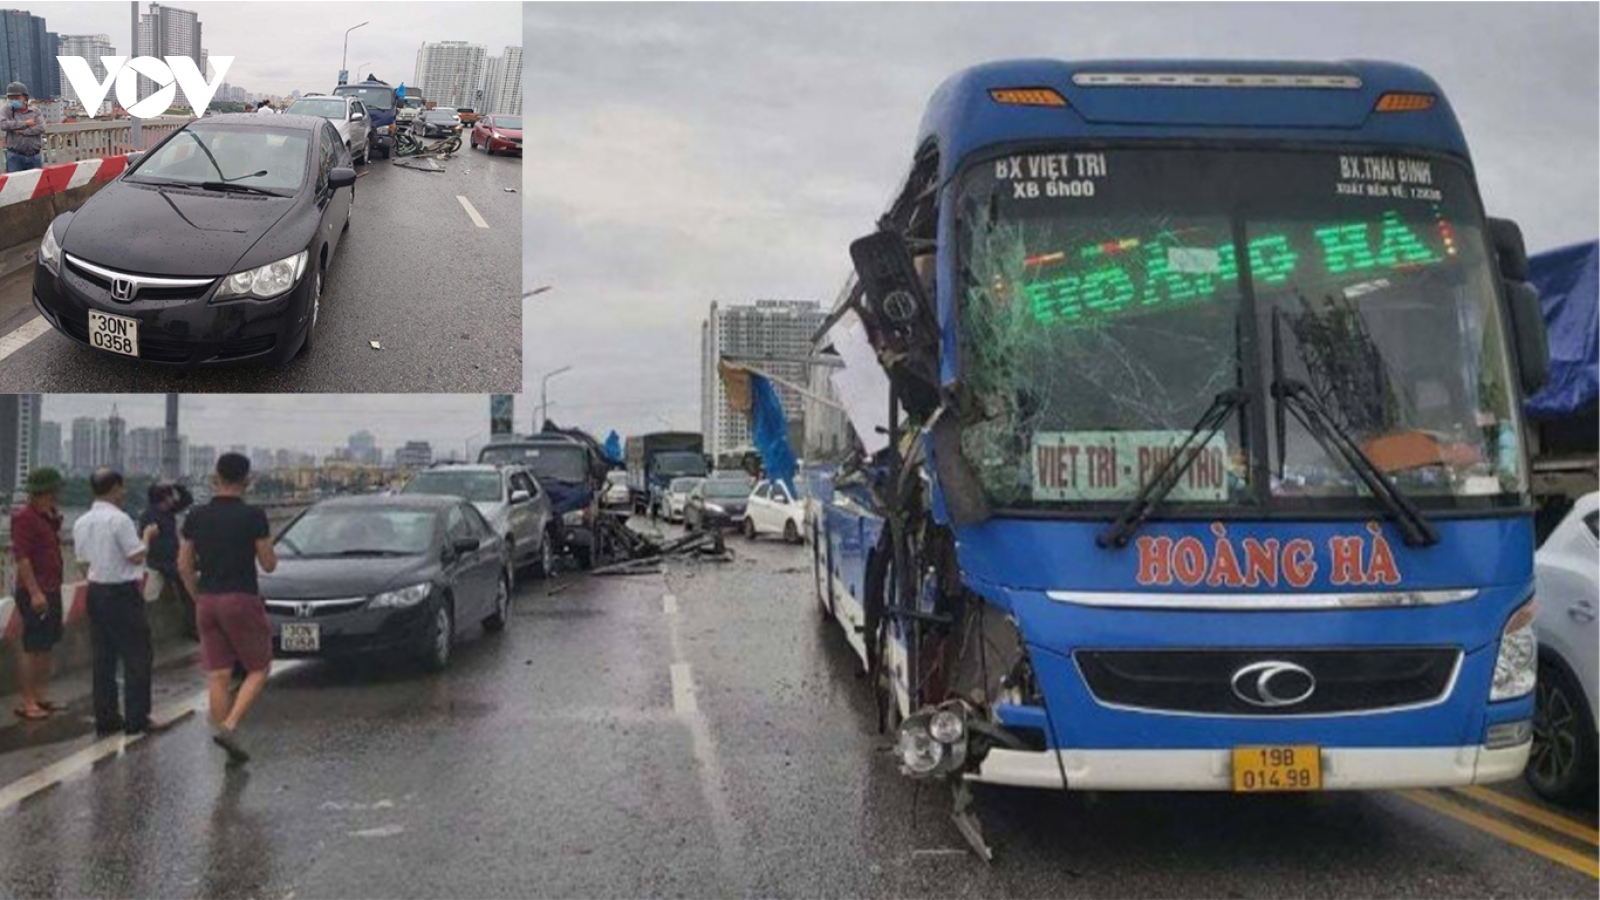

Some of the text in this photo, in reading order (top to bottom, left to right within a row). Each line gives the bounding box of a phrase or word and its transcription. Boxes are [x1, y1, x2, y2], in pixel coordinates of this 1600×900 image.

[1013, 181, 1039, 198] XB
[98, 315, 127, 336] 30N
[94, 331, 132, 353] 0358
[1037, 437, 1080, 498] VIỆT
[1136, 521, 1401, 587] HOÀNG HÀ
[1260, 748, 1294, 767] 19B
[1243, 768, 1310, 789] 014.98
